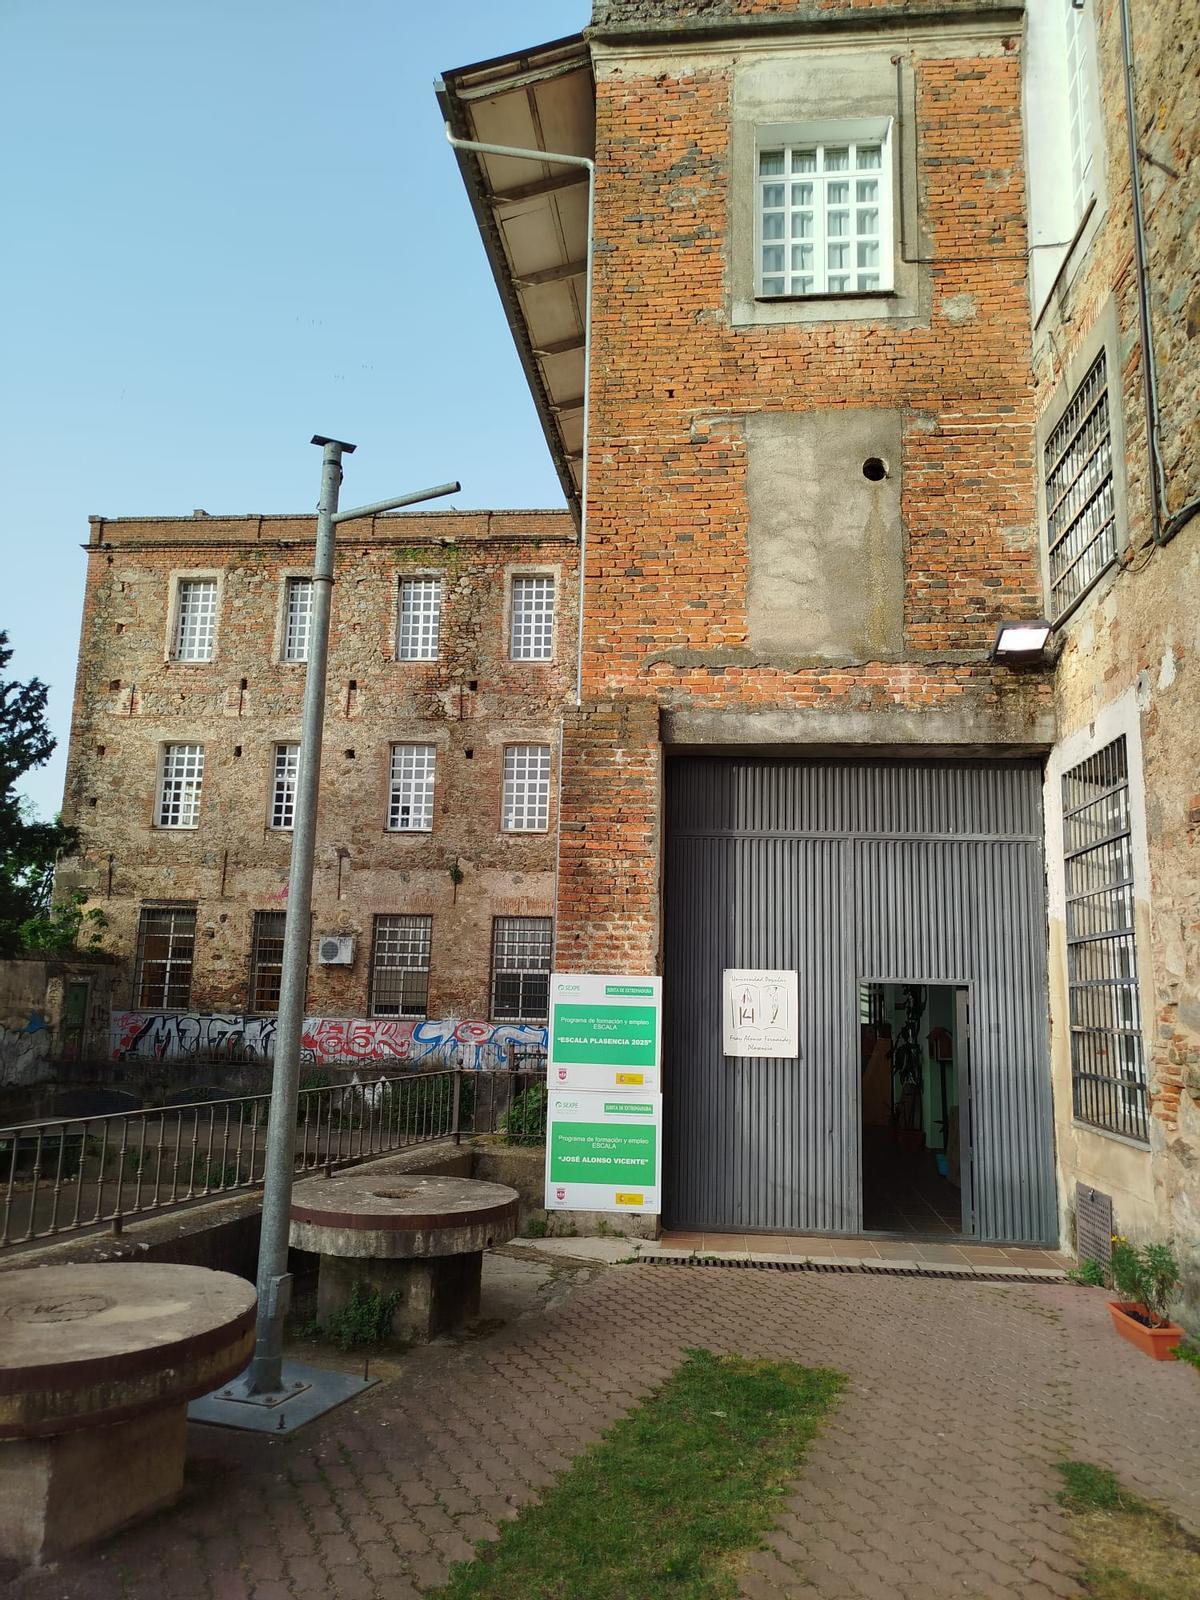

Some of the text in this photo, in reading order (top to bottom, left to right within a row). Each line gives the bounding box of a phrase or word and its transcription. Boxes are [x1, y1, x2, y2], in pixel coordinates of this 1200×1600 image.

[560, 1016, 587, 1024] Programa
[589, 1037, 629, 1045] PLASENCIA
[558, 1134, 585, 1142] Programa
[594, 1135, 622, 1143] formación
[581, 1156, 611, 1164] ALONSO
